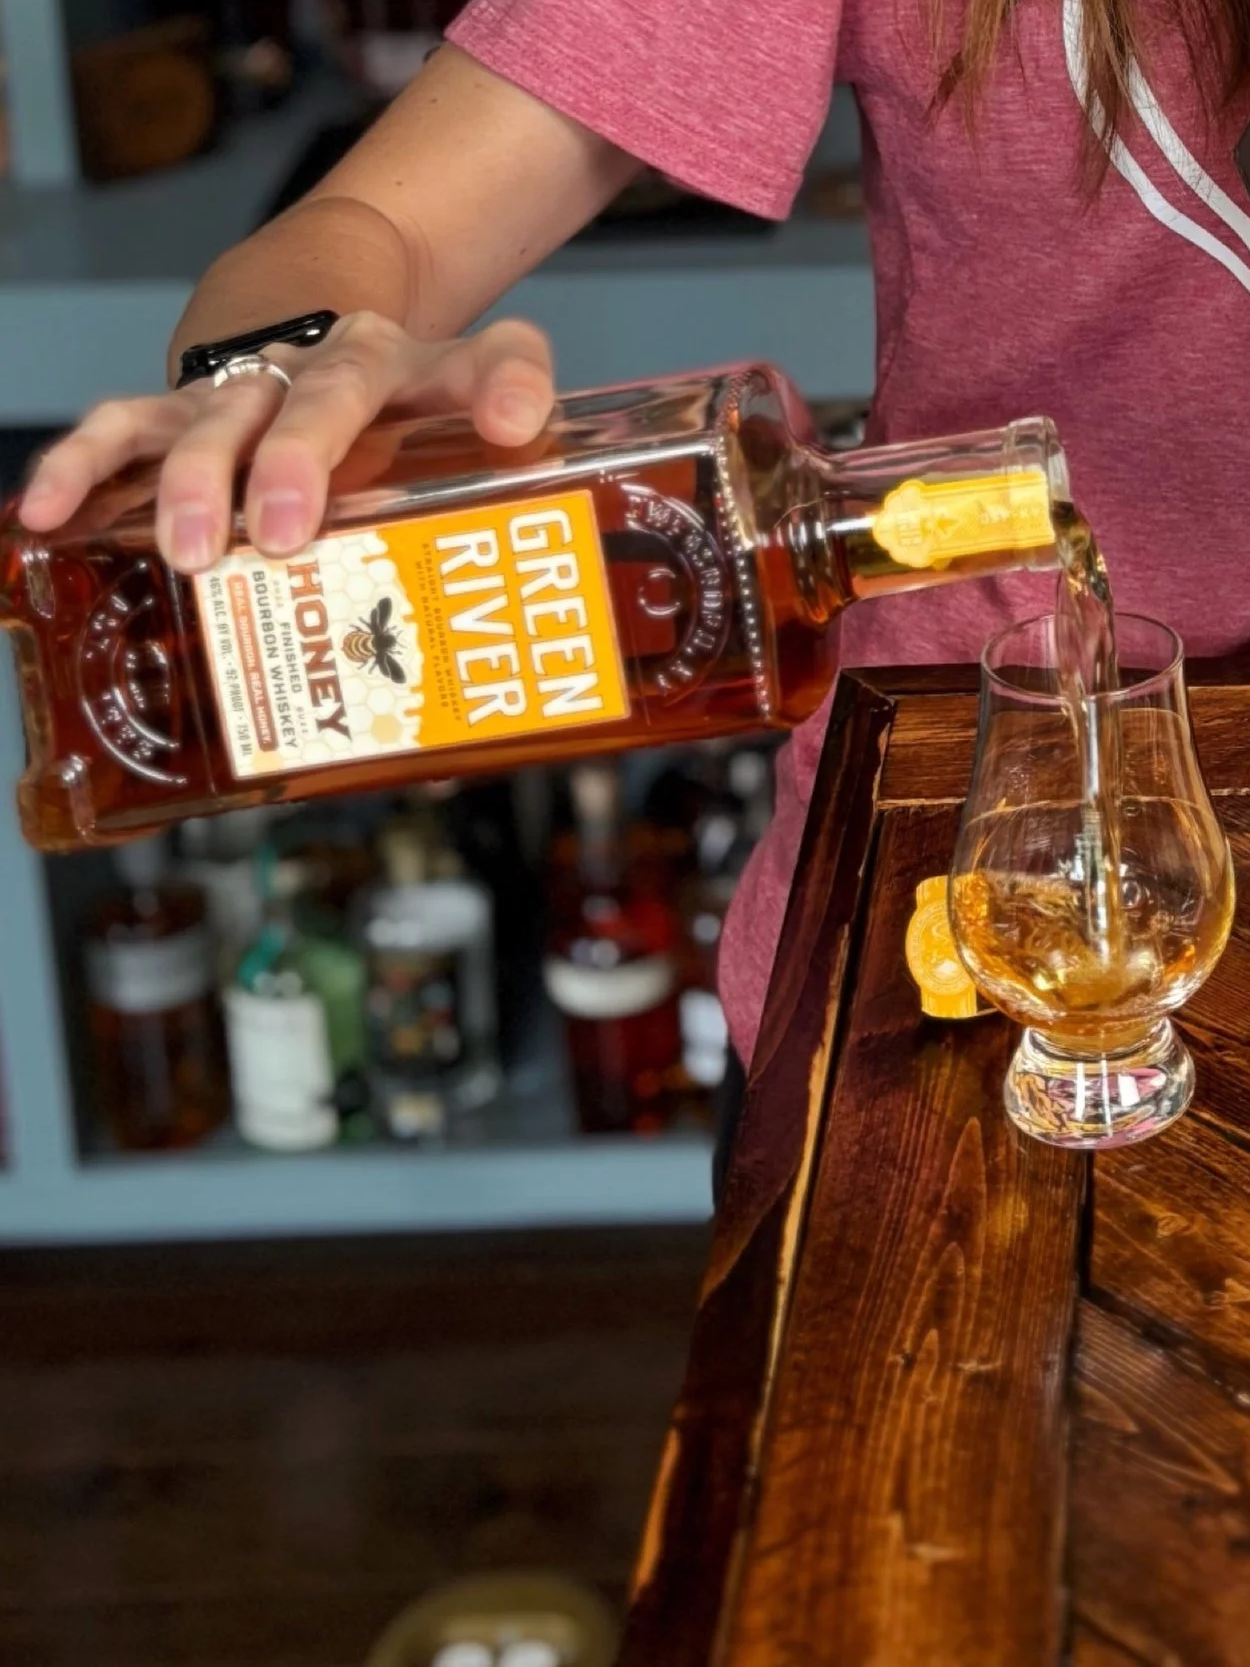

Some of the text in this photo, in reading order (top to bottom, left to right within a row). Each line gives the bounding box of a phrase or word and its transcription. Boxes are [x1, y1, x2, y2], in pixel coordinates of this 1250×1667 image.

[217, 622, 229, 636] BY
[225, 667, 238, 681] 92
[233, 580, 246, 612] REAL
[249, 671, 264, 704] REAL
[252, 570, 298, 749] BOURBON WHISKEY
[279, 622, 303, 694] FINISHED
[287, 560, 352, 743] HONEY
[435, 528, 528, 727] RIVER
[508, 509, 604, 717] GREEN
